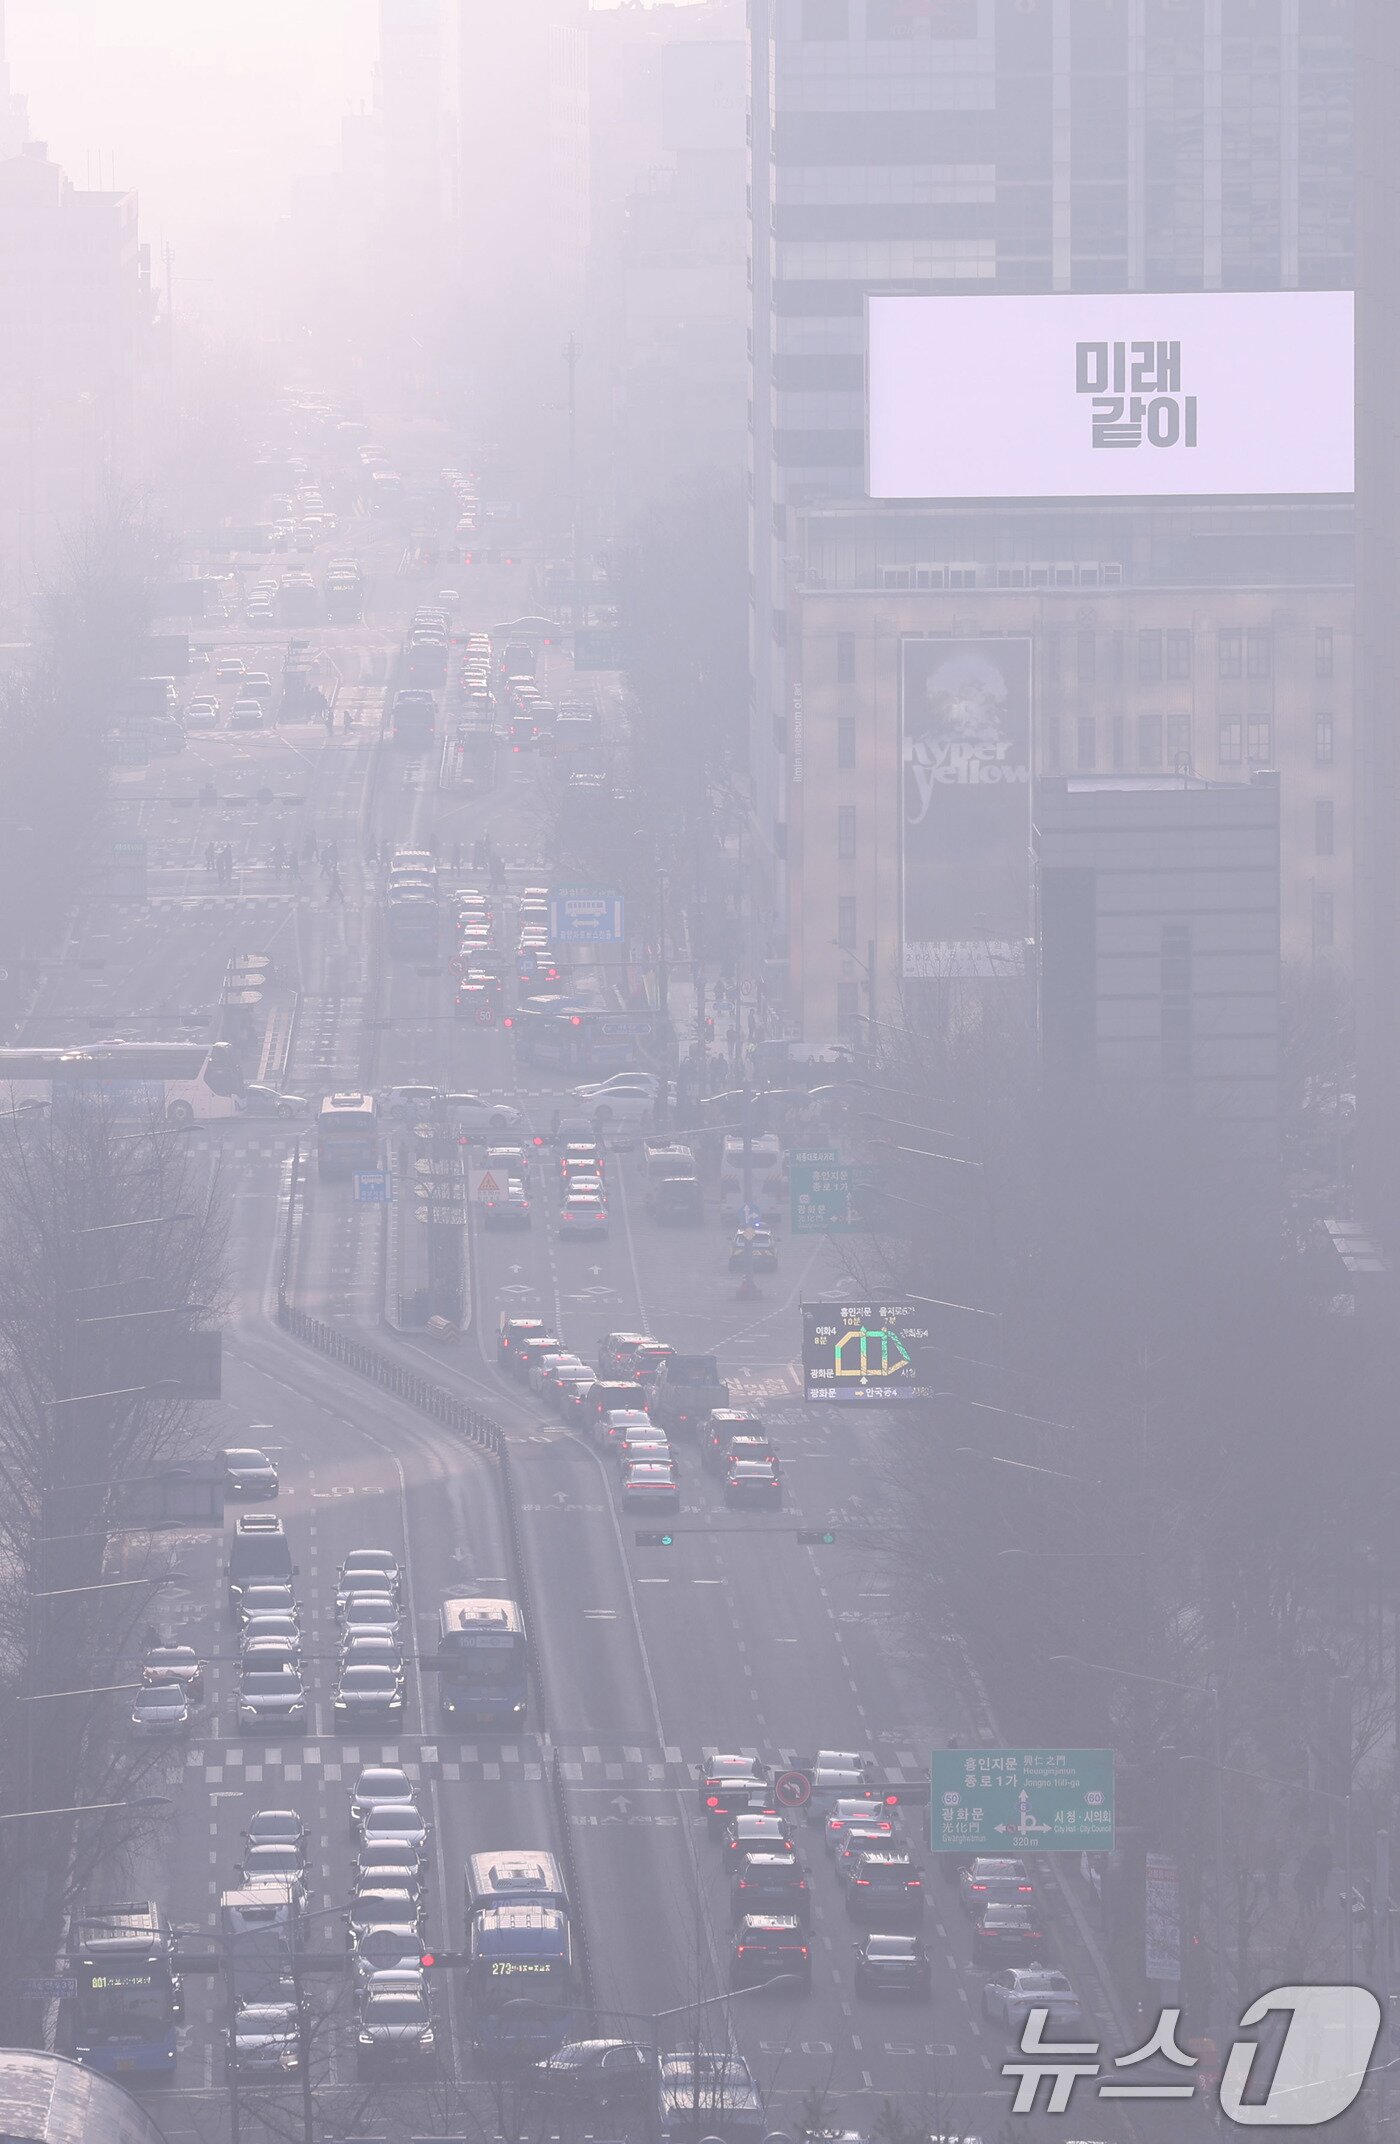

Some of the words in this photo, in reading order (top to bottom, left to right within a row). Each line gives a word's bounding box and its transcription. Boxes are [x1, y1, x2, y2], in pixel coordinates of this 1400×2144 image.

[1075, 340, 1182, 394] 미래
[1091, 396, 1197, 449] 같이
[792, 683, 802, 696] art
[792, 698, 802, 709] of
[793, 711, 802, 755] museum
[906, 759, 1031, 825] yellow
[479, 1011, 491, 1021] 50
[797, 1204, 826, 1215] 광화문
[840, 1307, 872, 1317] 흥인지문
[810, 1368, 834, 1379] 광화문
[810, 1387, 837, 1398] 광화문
[964, 1756, 1018, 1772] 흥인지문
[1023, 1778, 1052, 1788] Jongno
[1020, 1802, 1027, 1811] 6
[942, 1807, 984, 1822] 광화문
[942, 1822, 980, 1834] 光化門
[492, 1963, 512, 1975] 273
[883, 2042, 957, 2056] 50
